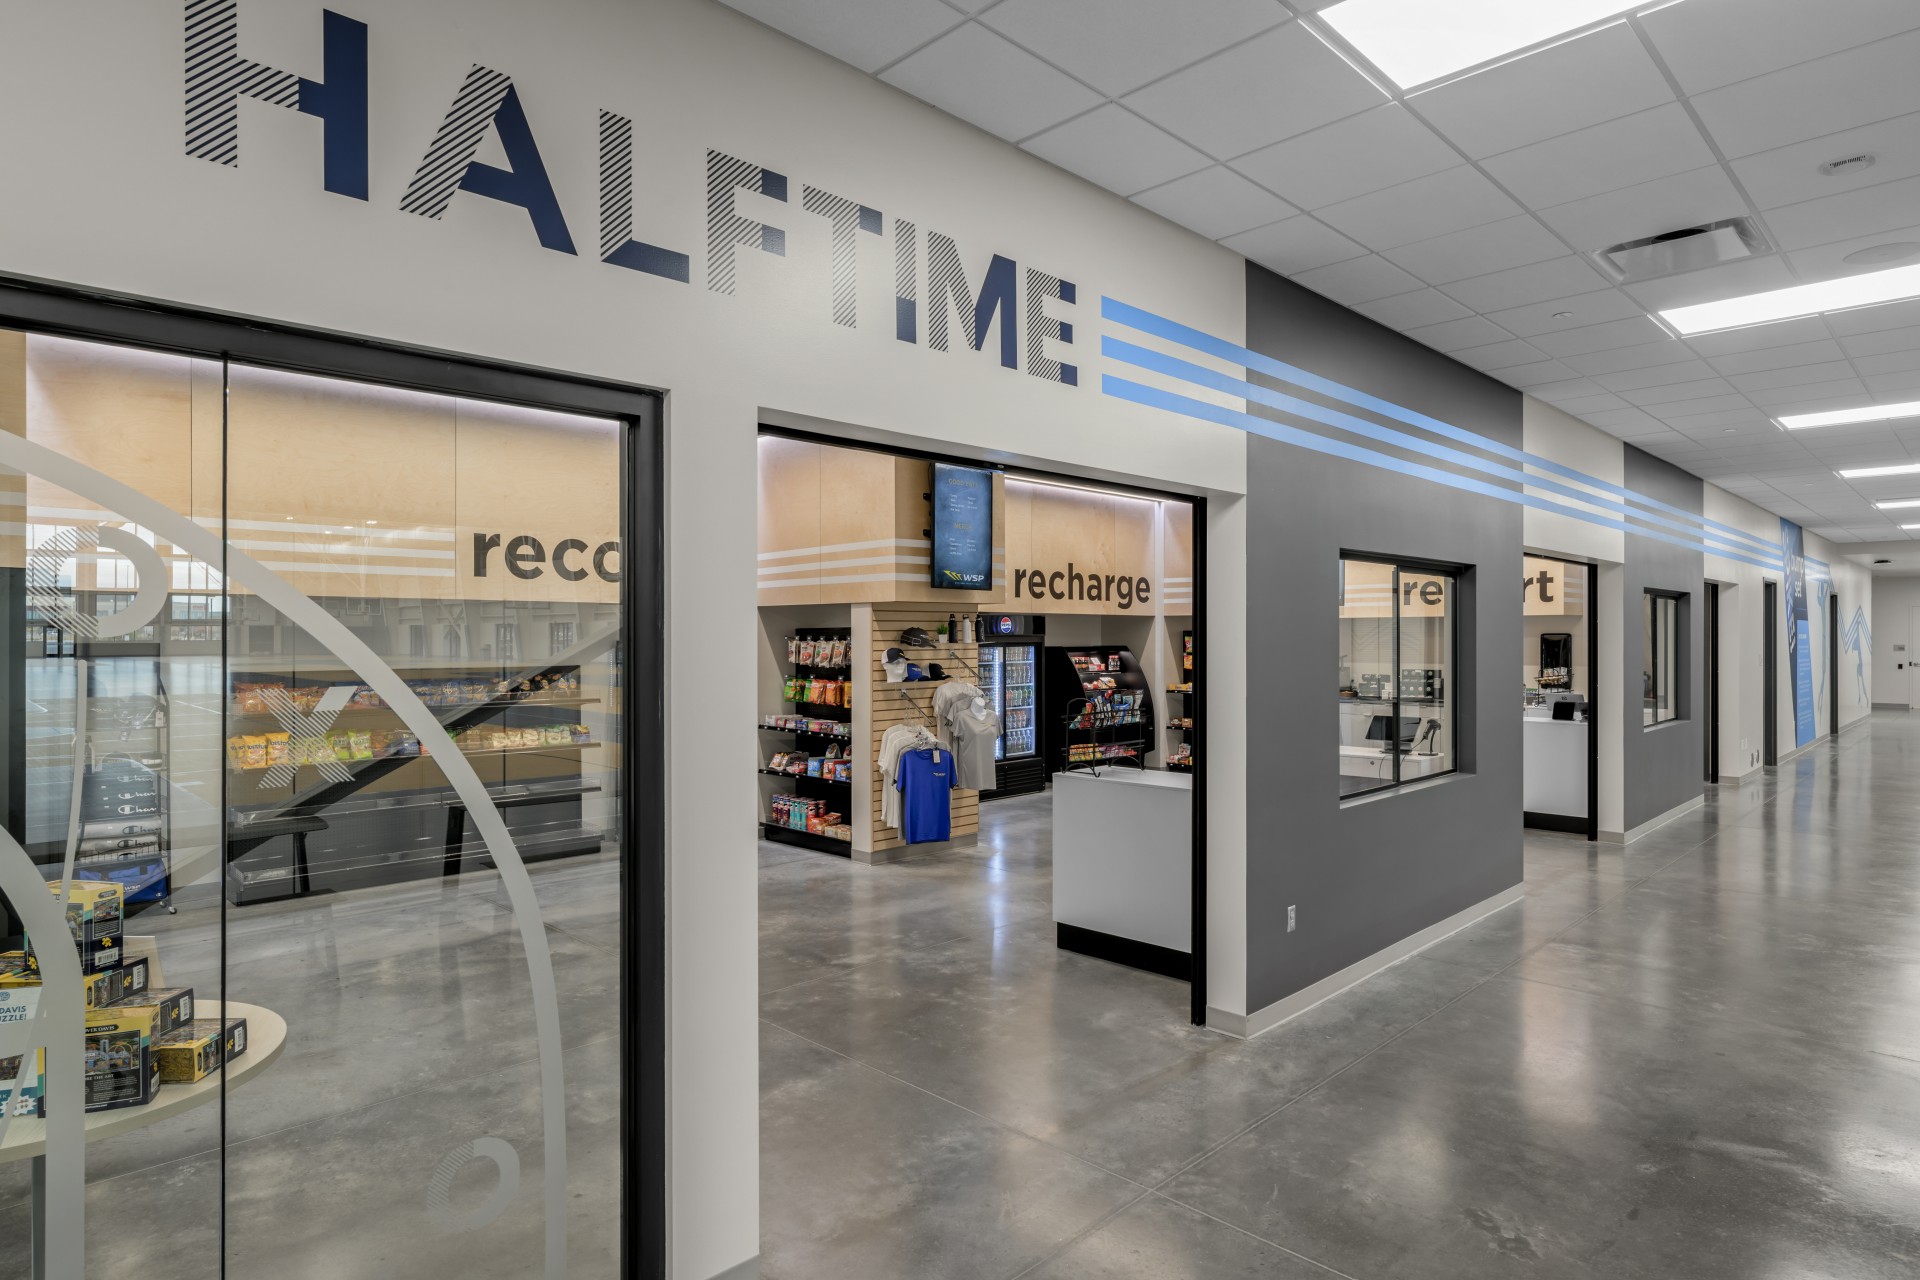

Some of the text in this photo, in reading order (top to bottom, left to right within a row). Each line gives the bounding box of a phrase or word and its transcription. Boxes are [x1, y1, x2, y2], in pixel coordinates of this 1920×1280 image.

[185, 0, 1078, 387] HALFTIME
[473, 532, 620, 583] reco
[963, 574, 985, 582] WSP
[1014, 562, 1151, 610] recharge
[1794, 578, 1803, 598] set
[0, 1005, 27, 1015] DAVIS
